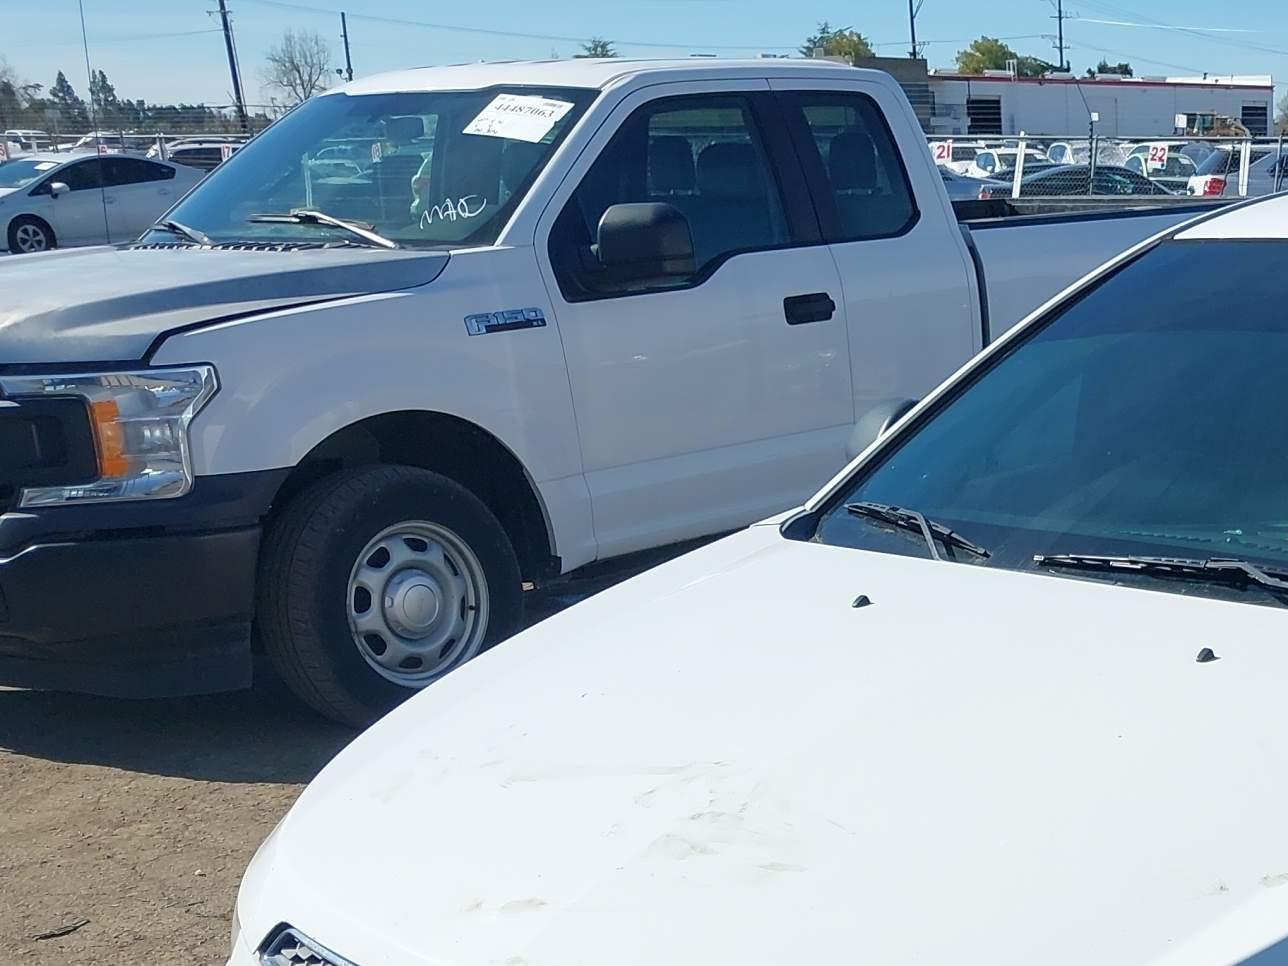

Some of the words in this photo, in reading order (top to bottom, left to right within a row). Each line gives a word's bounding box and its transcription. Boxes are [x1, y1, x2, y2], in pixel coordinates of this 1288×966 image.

[494, 103, 556, 119] 44487063
[936, 144, 950, 160] 21
[1151, 146, 1167, 162] 22
